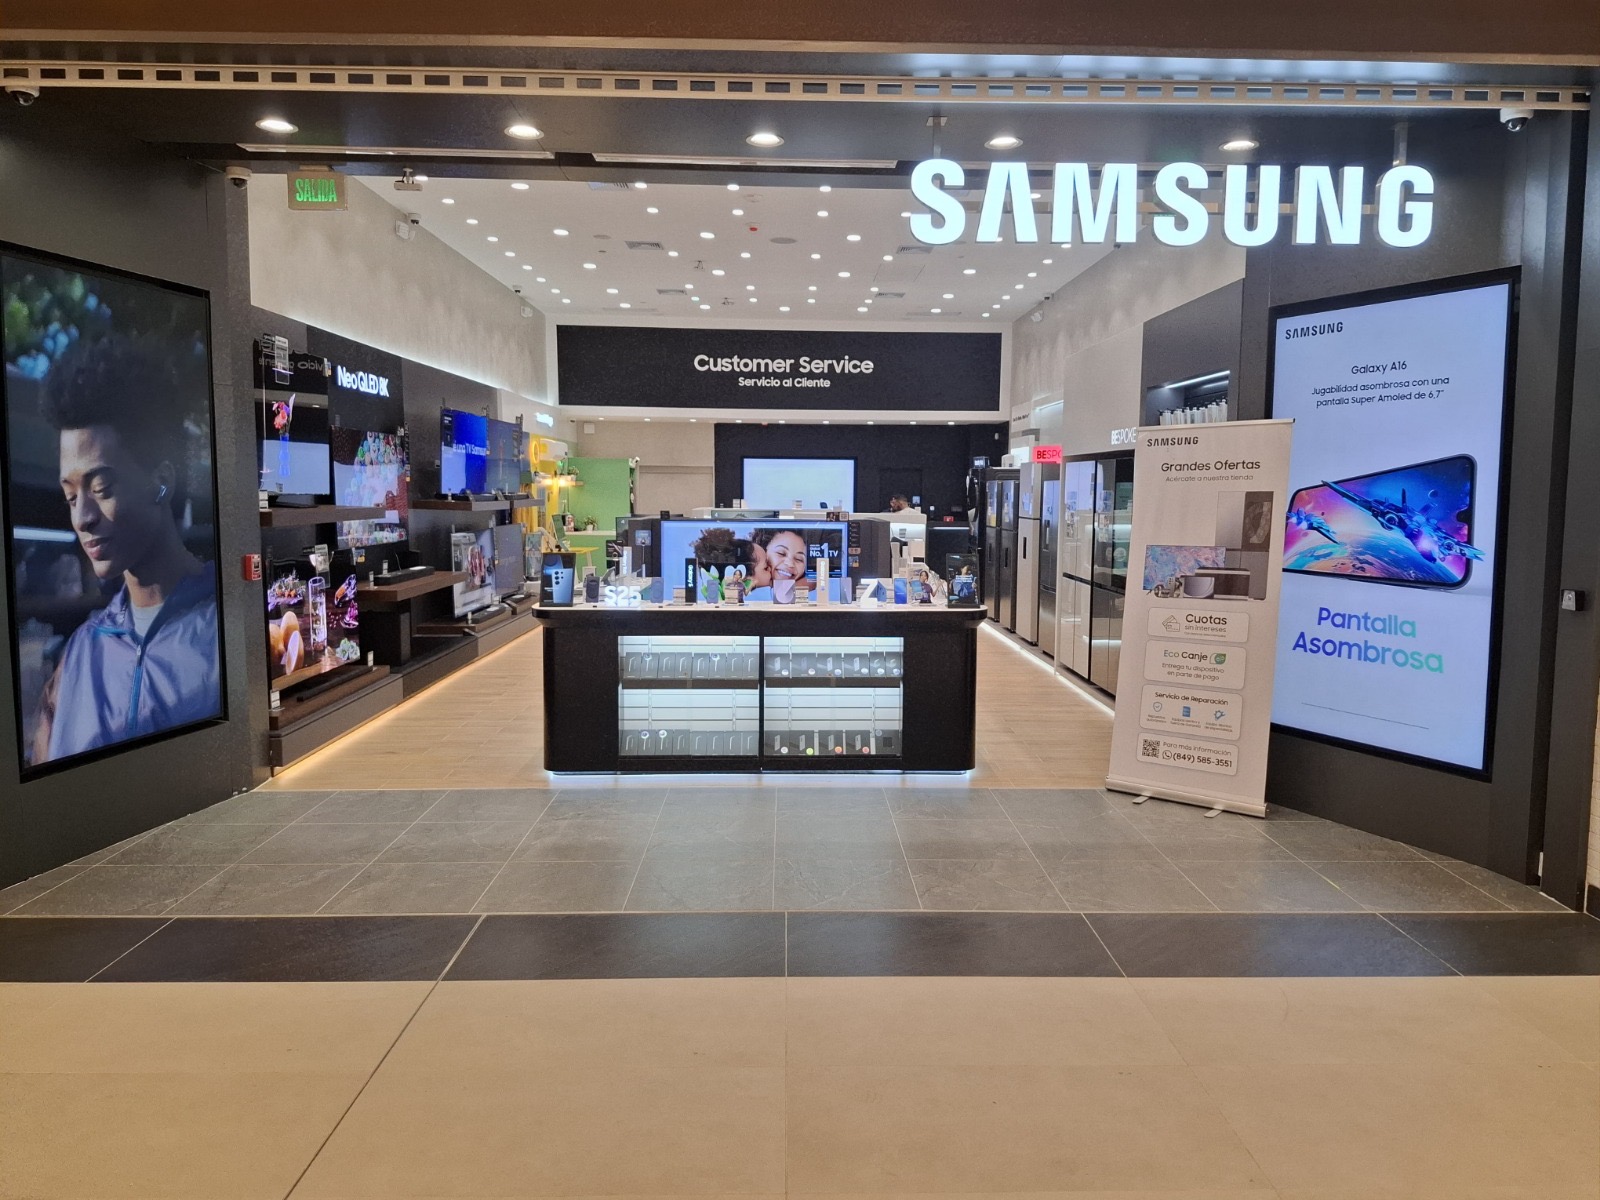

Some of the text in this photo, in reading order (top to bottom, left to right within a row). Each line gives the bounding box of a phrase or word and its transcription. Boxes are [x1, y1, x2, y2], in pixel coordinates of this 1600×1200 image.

[295, 178, 338, 202] SALIDA
[909, 158, 1435, 248] SAMSUNG
[1285, 322, 1344, 340] SAMSUNG
[693, 354, 874, 374] Customer Service
[1351, 361, 1408, 375] Galaxy A16
[337, 365, 358, 390] Neo
[357, 371, 379, 394] QLED
[738, 376, 831, 388] Servicio al Cliente
[1311, 376, 1450, 396] Jugabilidad asombrosa con una
[1316, 397, 1350, 408] pantalla
[1351, 395, 1376, 405] Super
[1377, 392, 1412, 402] Amoled
[1413, 390, 1426, 399] de
[1111, 427, 1137, 445] BESPOKE
[1146, 436, 1199, 447] SAMSUNG
[1161, 459, 1261, 472] Grandes Ofertas
[809, 550, 822, 558] No.
[828, 550, 839, 558] TV
[604, 585, 642, 607] S25
[859, 578, 879, 608] Z
[1185, 613, 1228, 625] Cuotas
[1317, 607, 1417, 638] Pantalla
[1195, 625, 1227, 633] intereses
[1163, 649, 1208, 662] Eco Canje
[1292, 631, 1444, 673] Asombrosa
[1161, 662, 1185, 671] Entrega
[1192, 665, 1225, 674] dispositivo
[1202, 674, 1220, 682] pago
[1155, 691, 1180, 700] Servicio
[1190, 696, 1229, 706] Reparación
[1163, 741, 1232, 757] Para más información
[1172, 752, 1233, 768] (849) 585-3551
